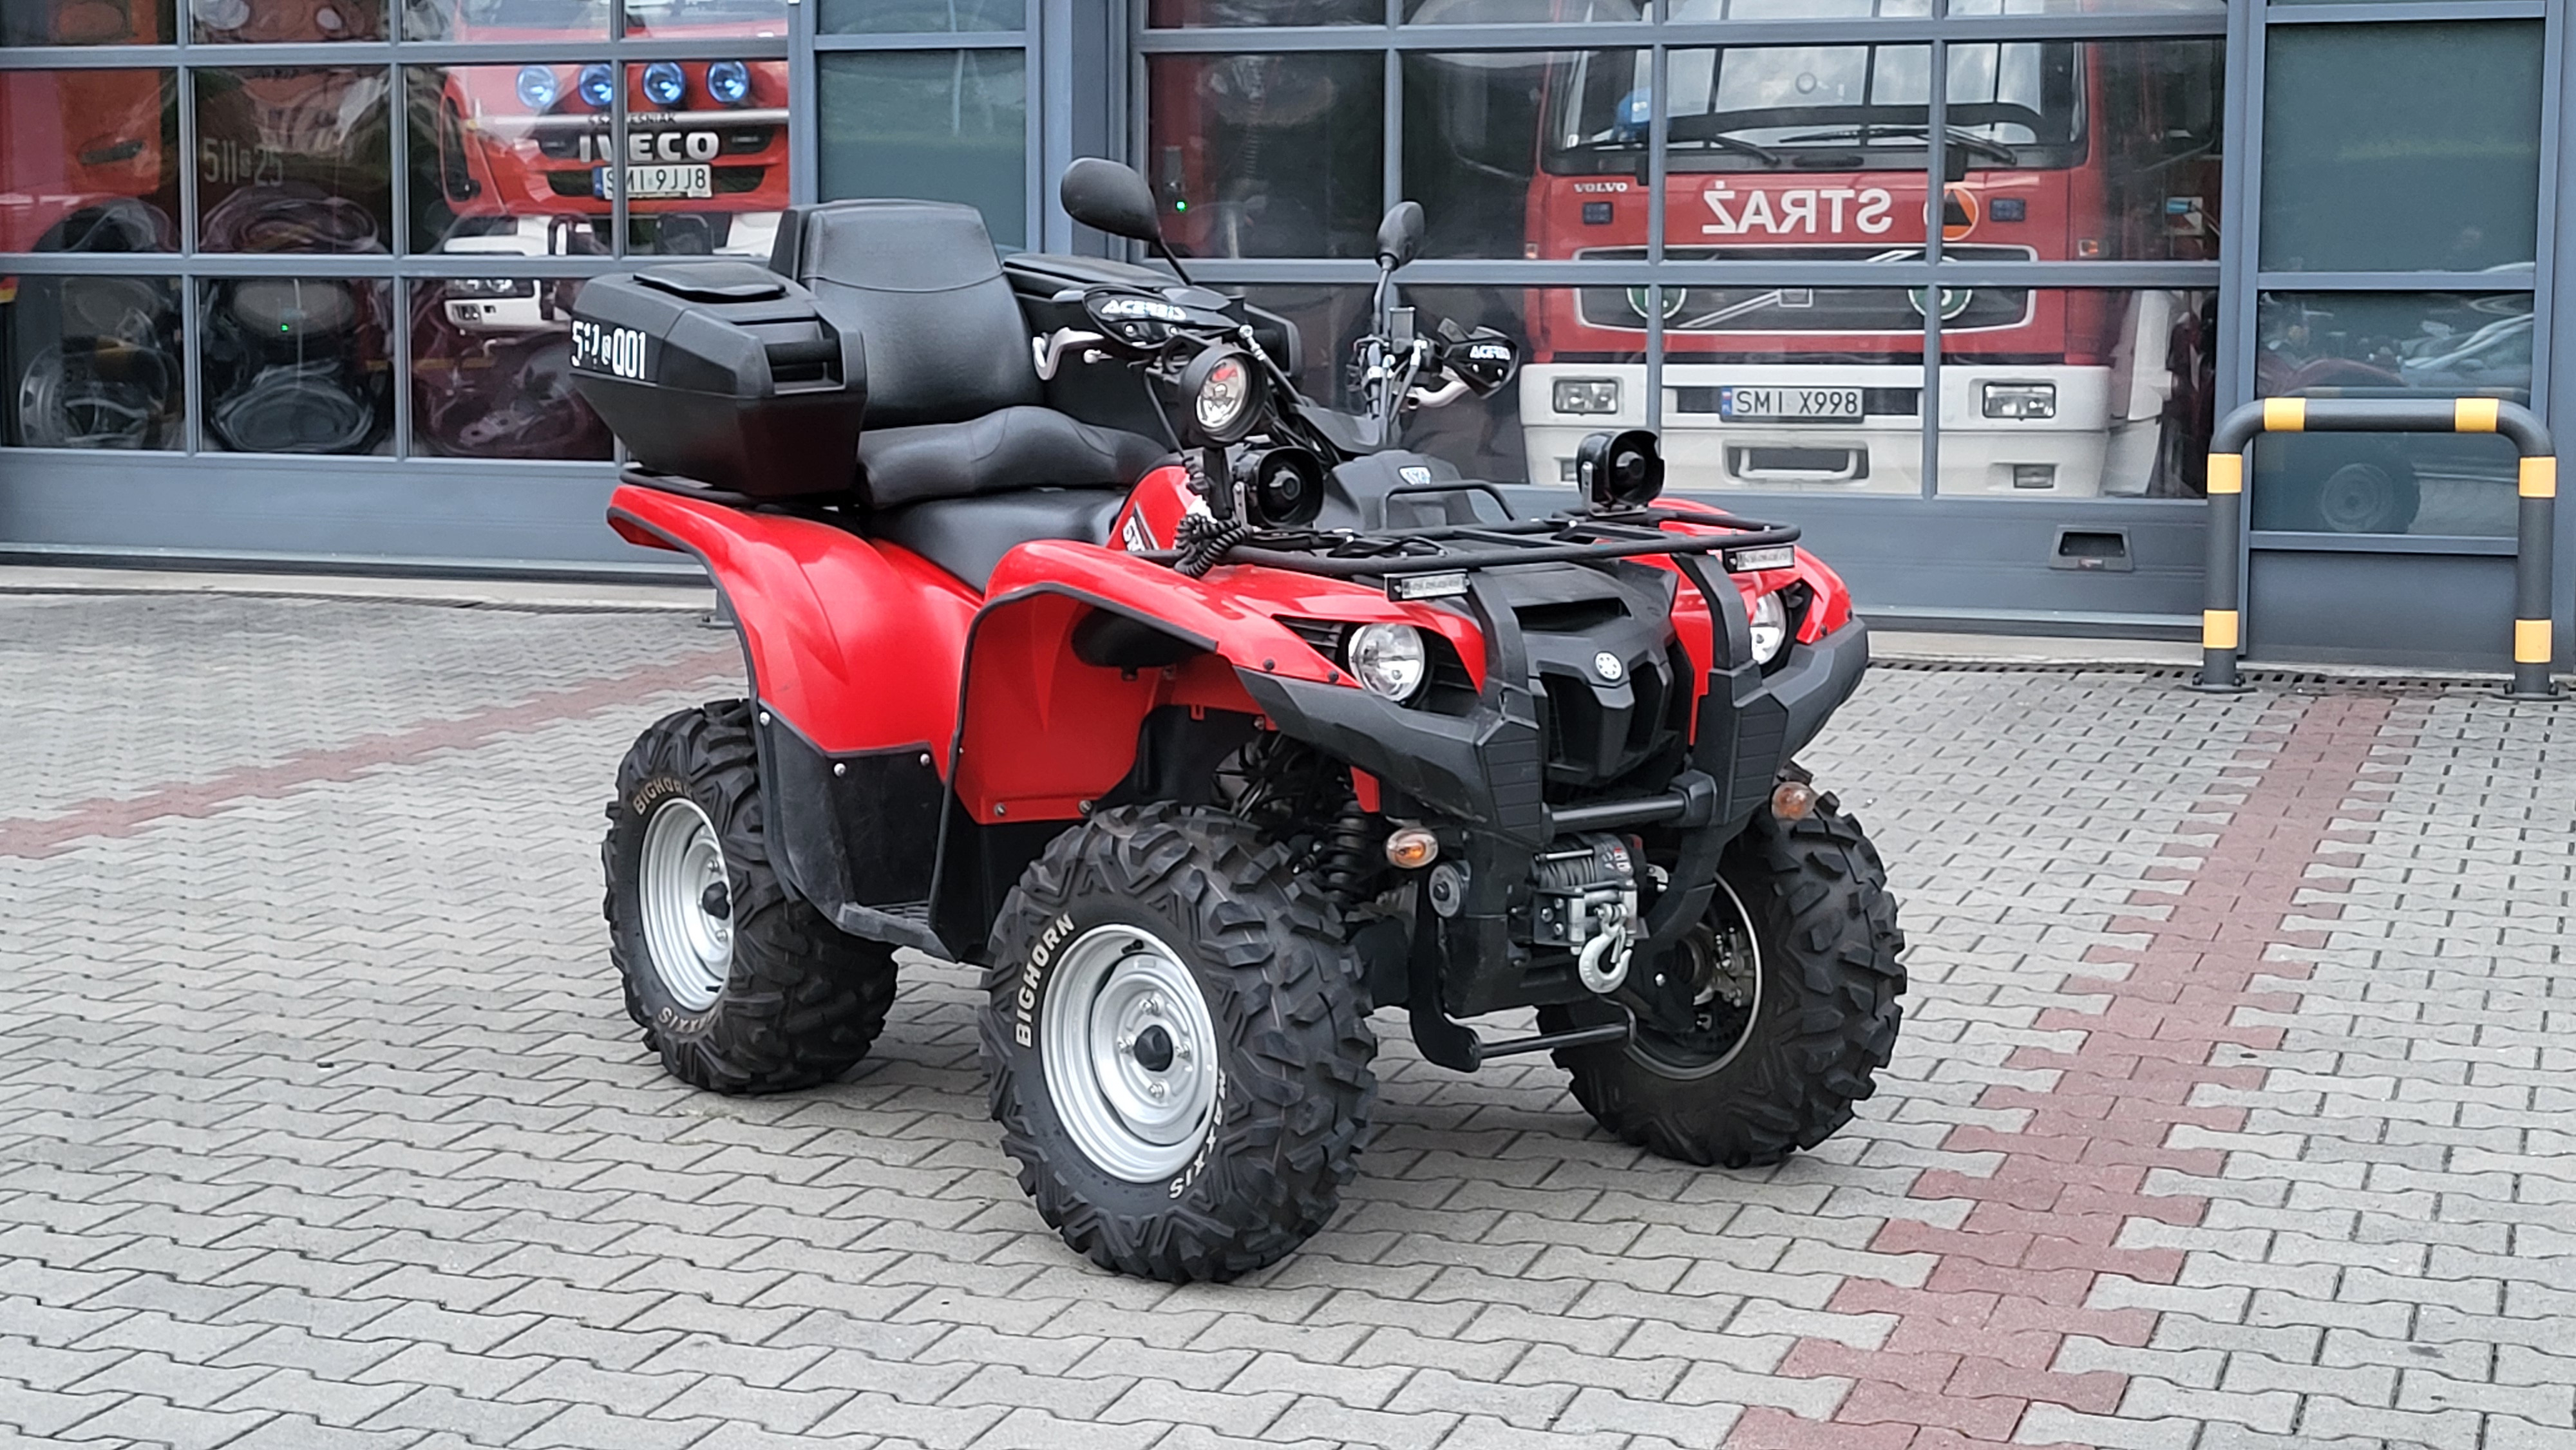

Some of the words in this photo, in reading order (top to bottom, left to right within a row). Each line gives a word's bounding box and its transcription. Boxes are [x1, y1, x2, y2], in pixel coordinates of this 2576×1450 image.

[579, 131, 719, 163] IVECO
[656, 167, 706, 191] 9JJ8
[1573, 182, 1629, 193] VOLVO
[1736, 390, 1783, 413] SMI
[1799, 391, 1857, 414] X998
[1016, 911, 1075, 1048] BIGHORN
[1168, 1067, 1226, 1199] MAXXIS
